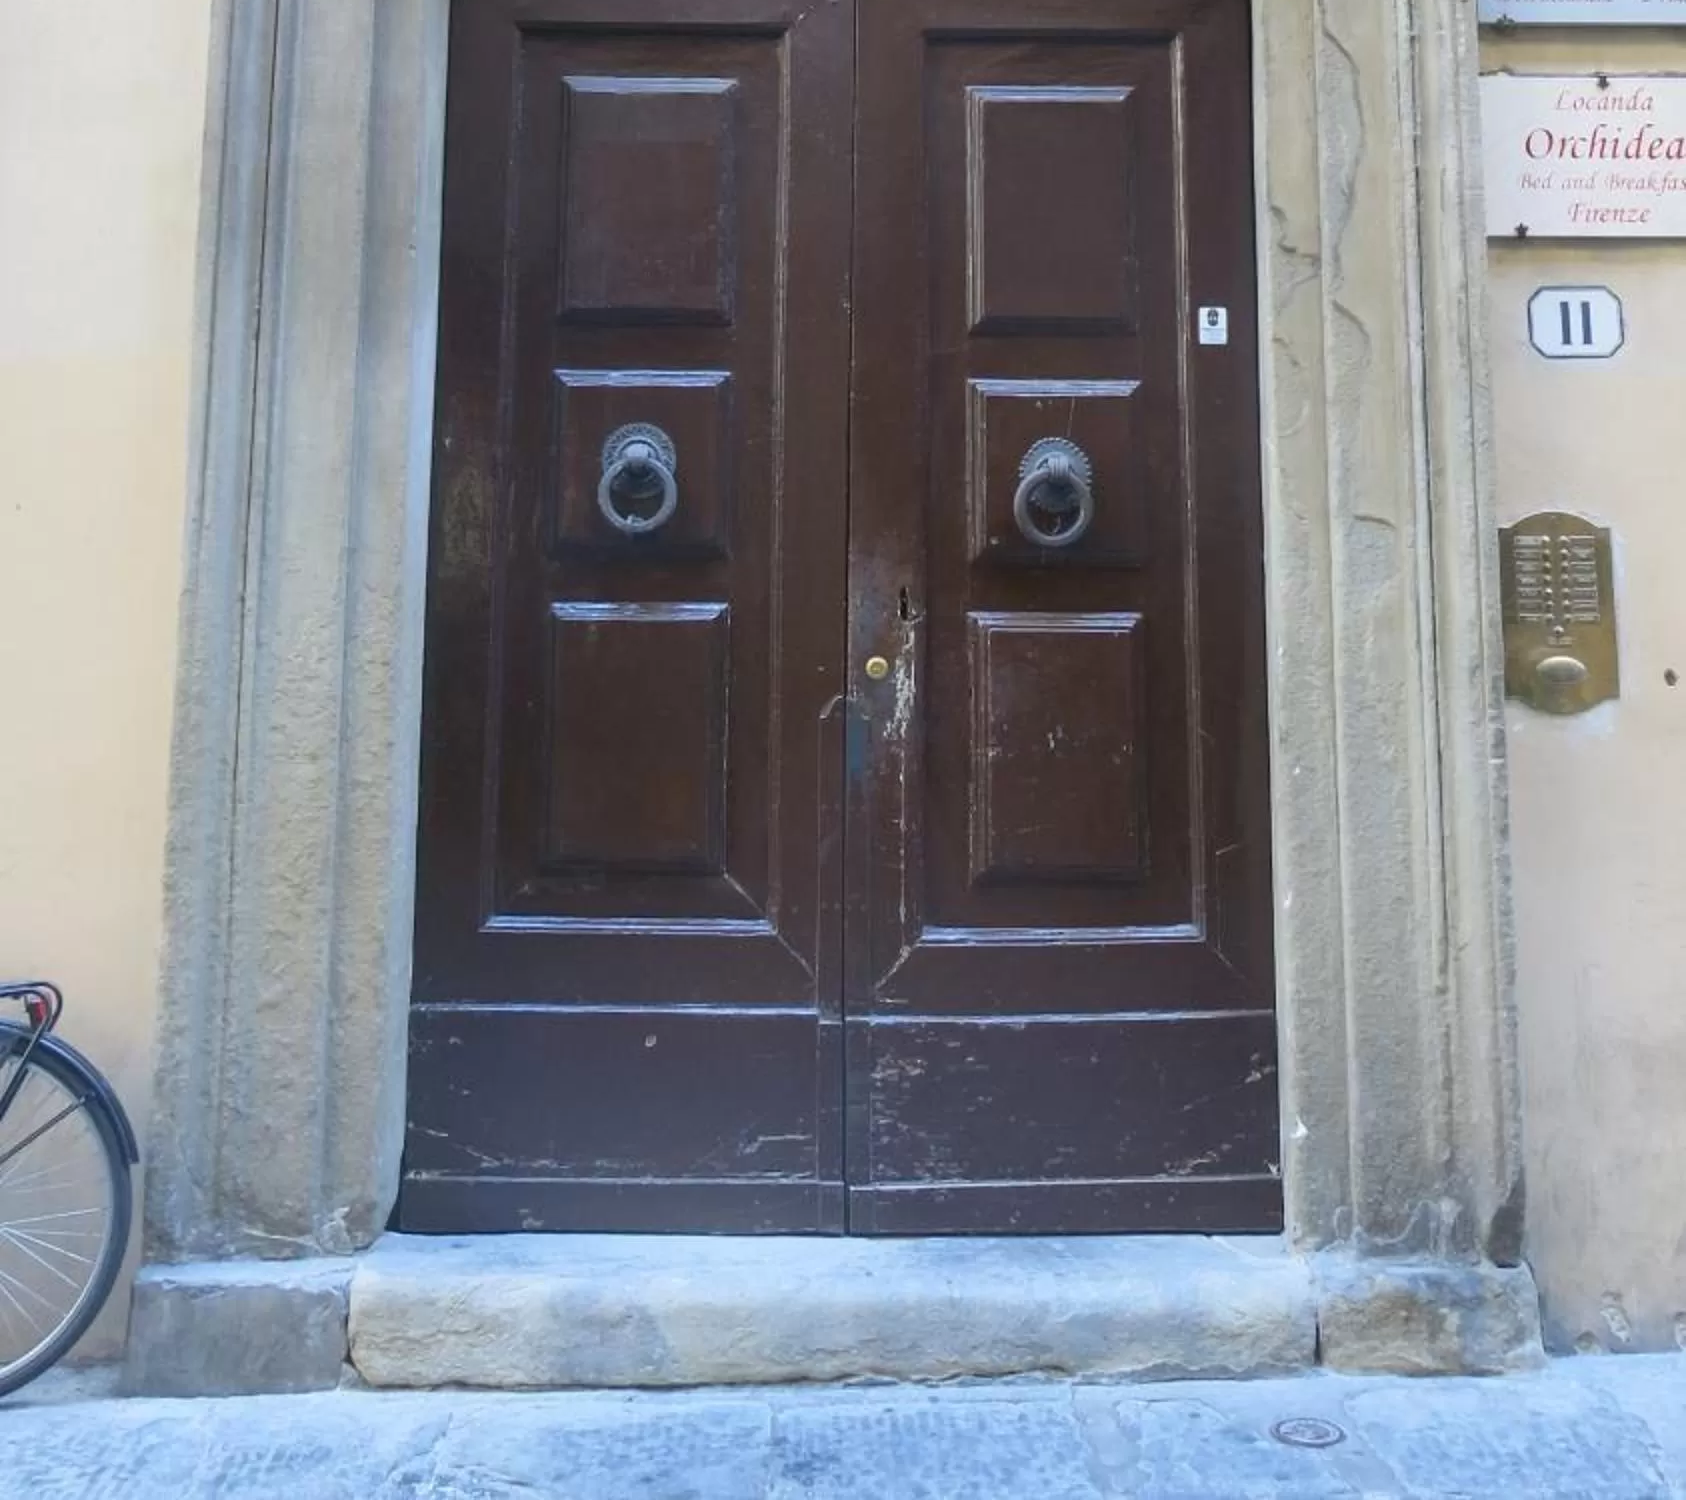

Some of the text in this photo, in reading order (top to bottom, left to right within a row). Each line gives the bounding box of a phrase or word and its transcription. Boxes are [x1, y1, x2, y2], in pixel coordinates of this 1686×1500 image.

[1555, 86, 1654, 111] Locanda
[1525, 123, 1686, 160] Orchidea
[1520, 172, 1551, 190] Bed
[1561, 172, 1596, 190] and
[1567, 202, 1651, 223] Firenze
[1559, 301, 1593, 345] 11
